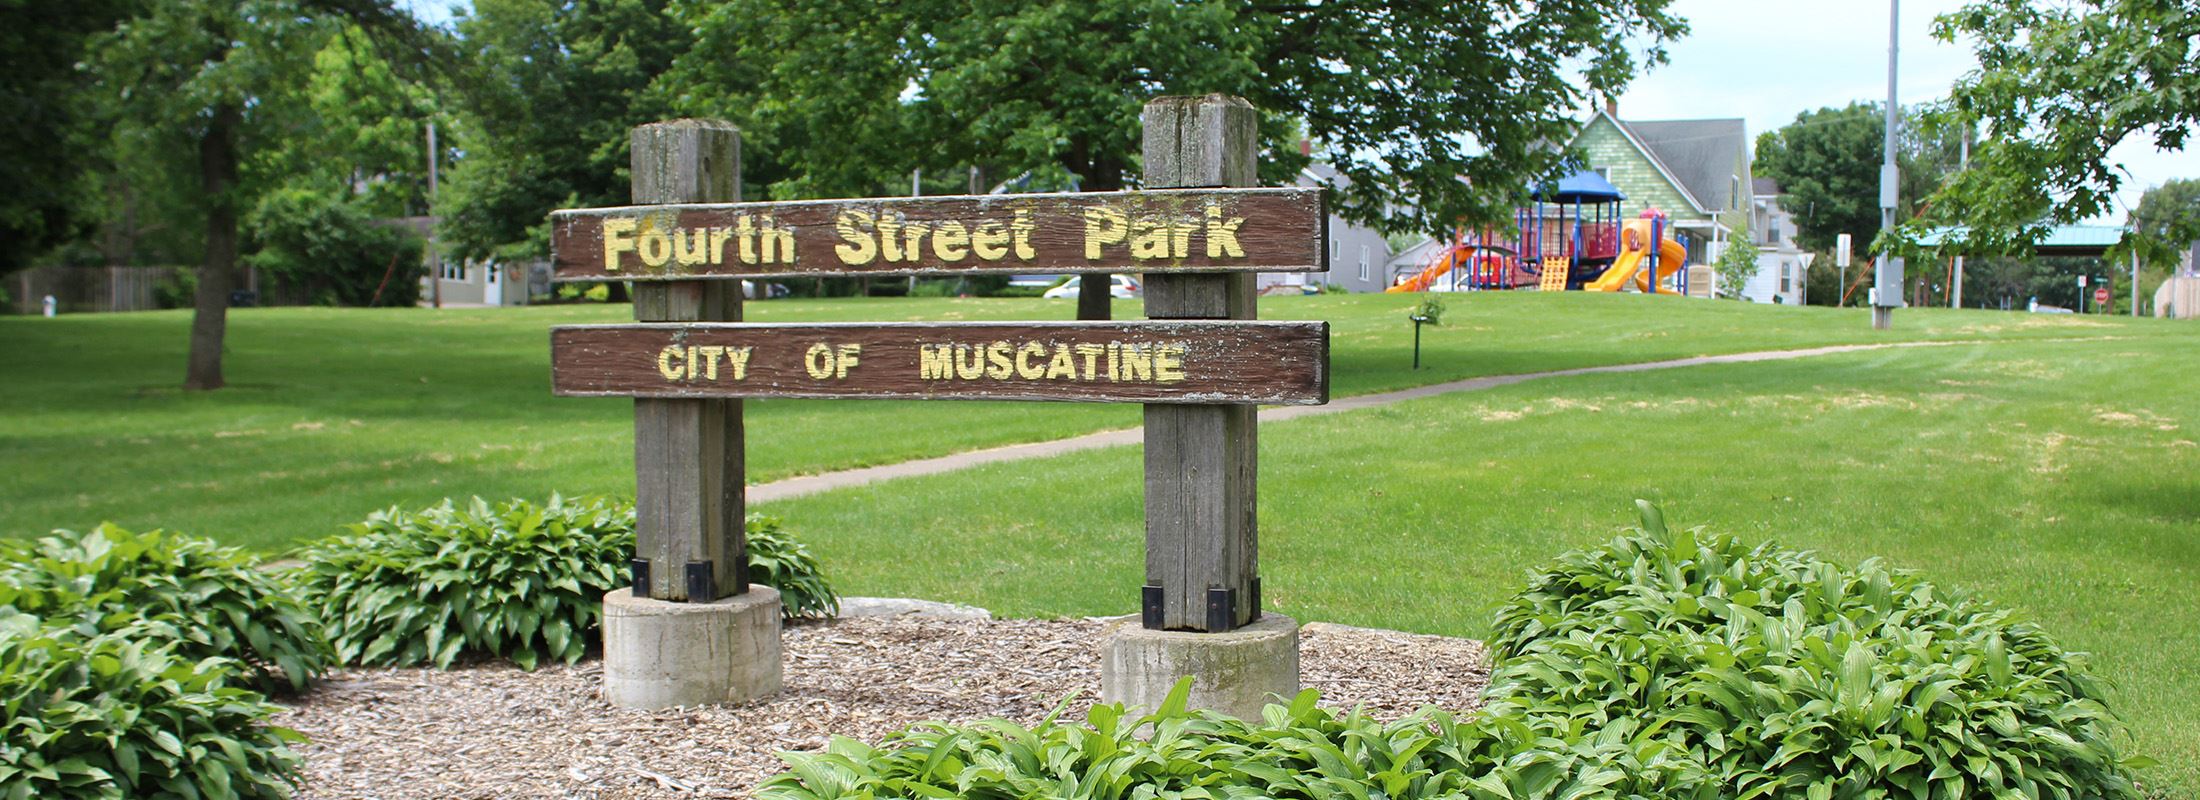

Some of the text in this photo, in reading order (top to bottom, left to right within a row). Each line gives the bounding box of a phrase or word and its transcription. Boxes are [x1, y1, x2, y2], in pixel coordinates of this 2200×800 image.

[603, 205, 1246, 270] Fourth Street Park
[658, 342, 1185, 382] CITY OF MUSCATINE
